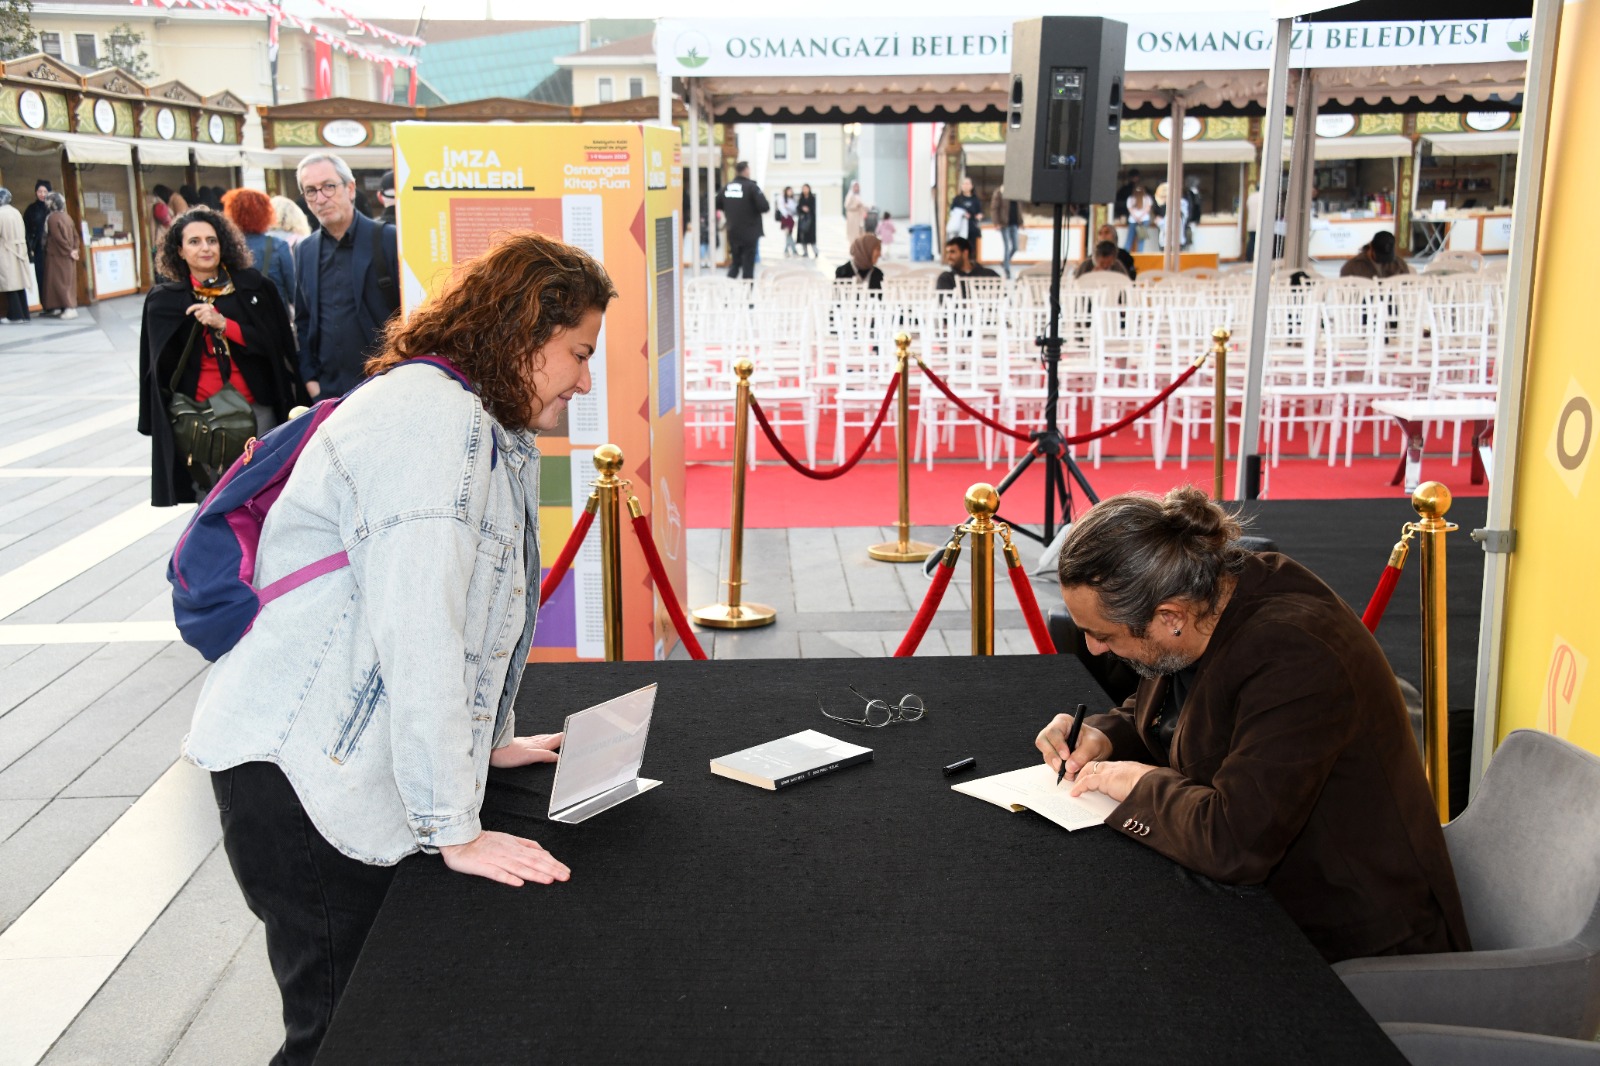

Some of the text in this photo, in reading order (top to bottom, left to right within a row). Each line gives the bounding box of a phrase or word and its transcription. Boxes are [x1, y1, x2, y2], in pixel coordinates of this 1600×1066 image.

[725, 30, 1010, 58] OSMANGAZİ BELEDİ
[1325, 20, 1489, 49] BELEDİYESİ
[443, 145, 501, 168] İMZA
[423, 166, 524, 189] GÜNLERİ
[563, 164, 630, 178] Osmangazi
[563, 177, 597, 192] Kitap
